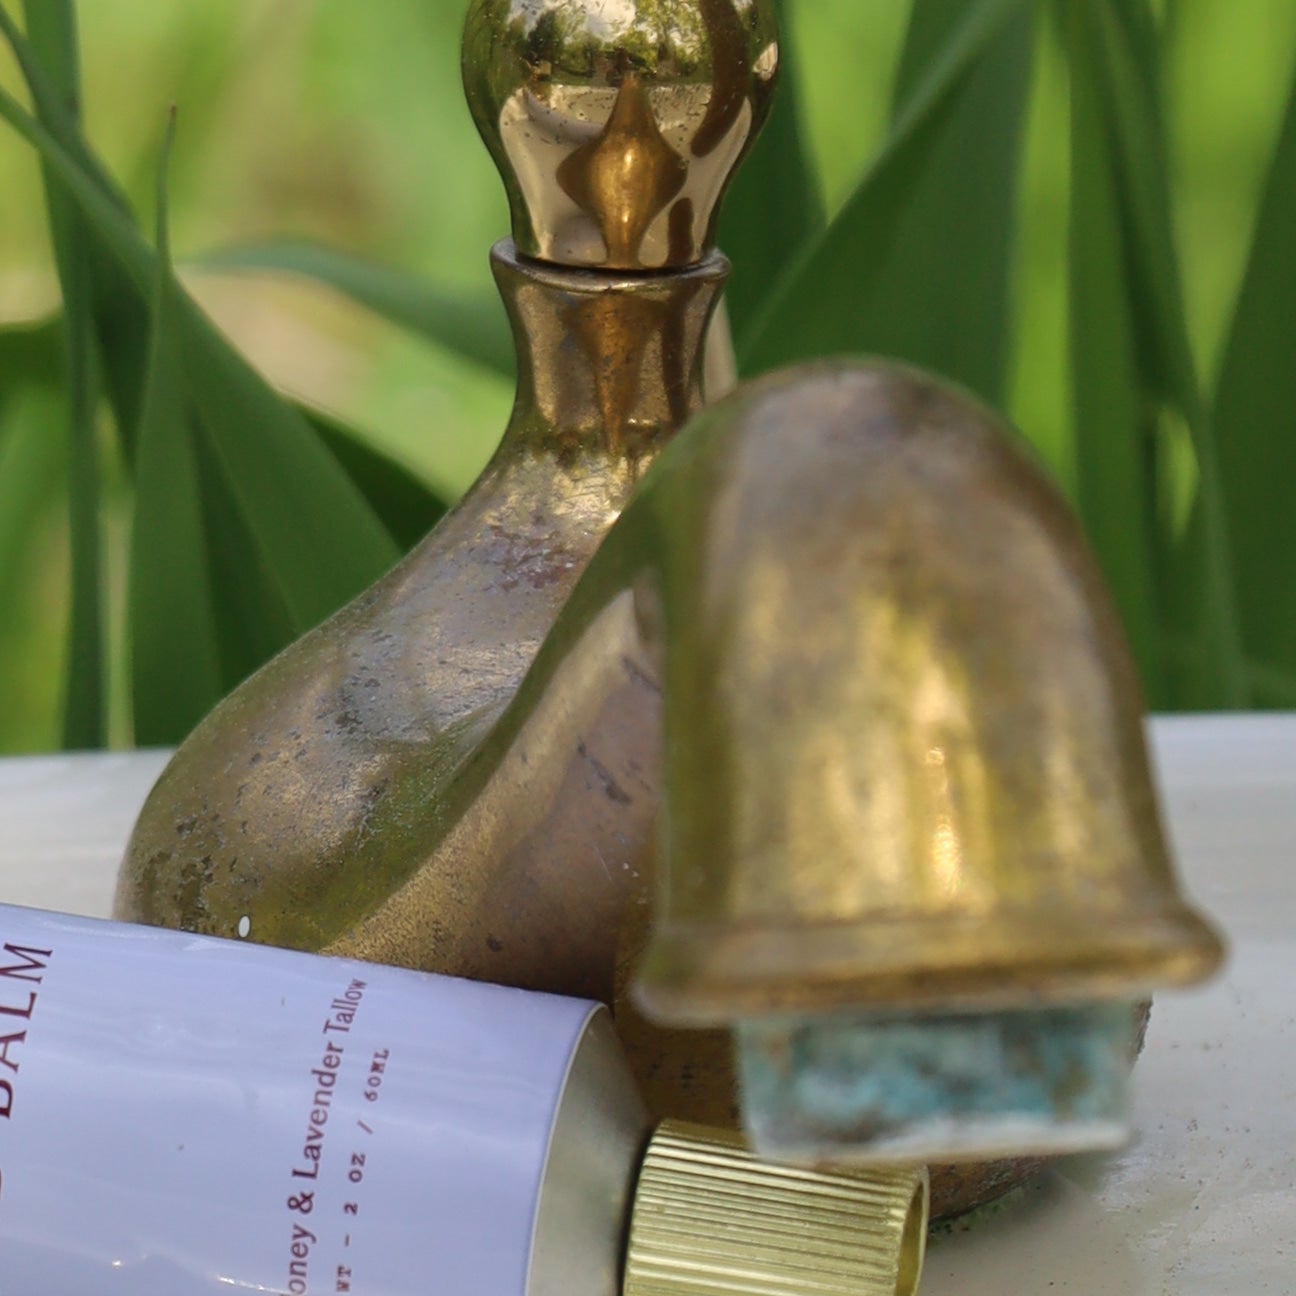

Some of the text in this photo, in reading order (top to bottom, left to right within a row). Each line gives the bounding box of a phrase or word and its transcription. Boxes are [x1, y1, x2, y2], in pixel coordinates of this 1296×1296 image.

[323, 977, 368, 1036] Tallow
[364, 1047, 390, 1103] 60ML
[292, 1041, 344, 1180] Lavender
[349, 1152, 366, 1184] OZ
[287, 1191, 314, 1215] &
[344, 1202, 358, 1216] 2
[337, 1264, 351, 1293] WT
